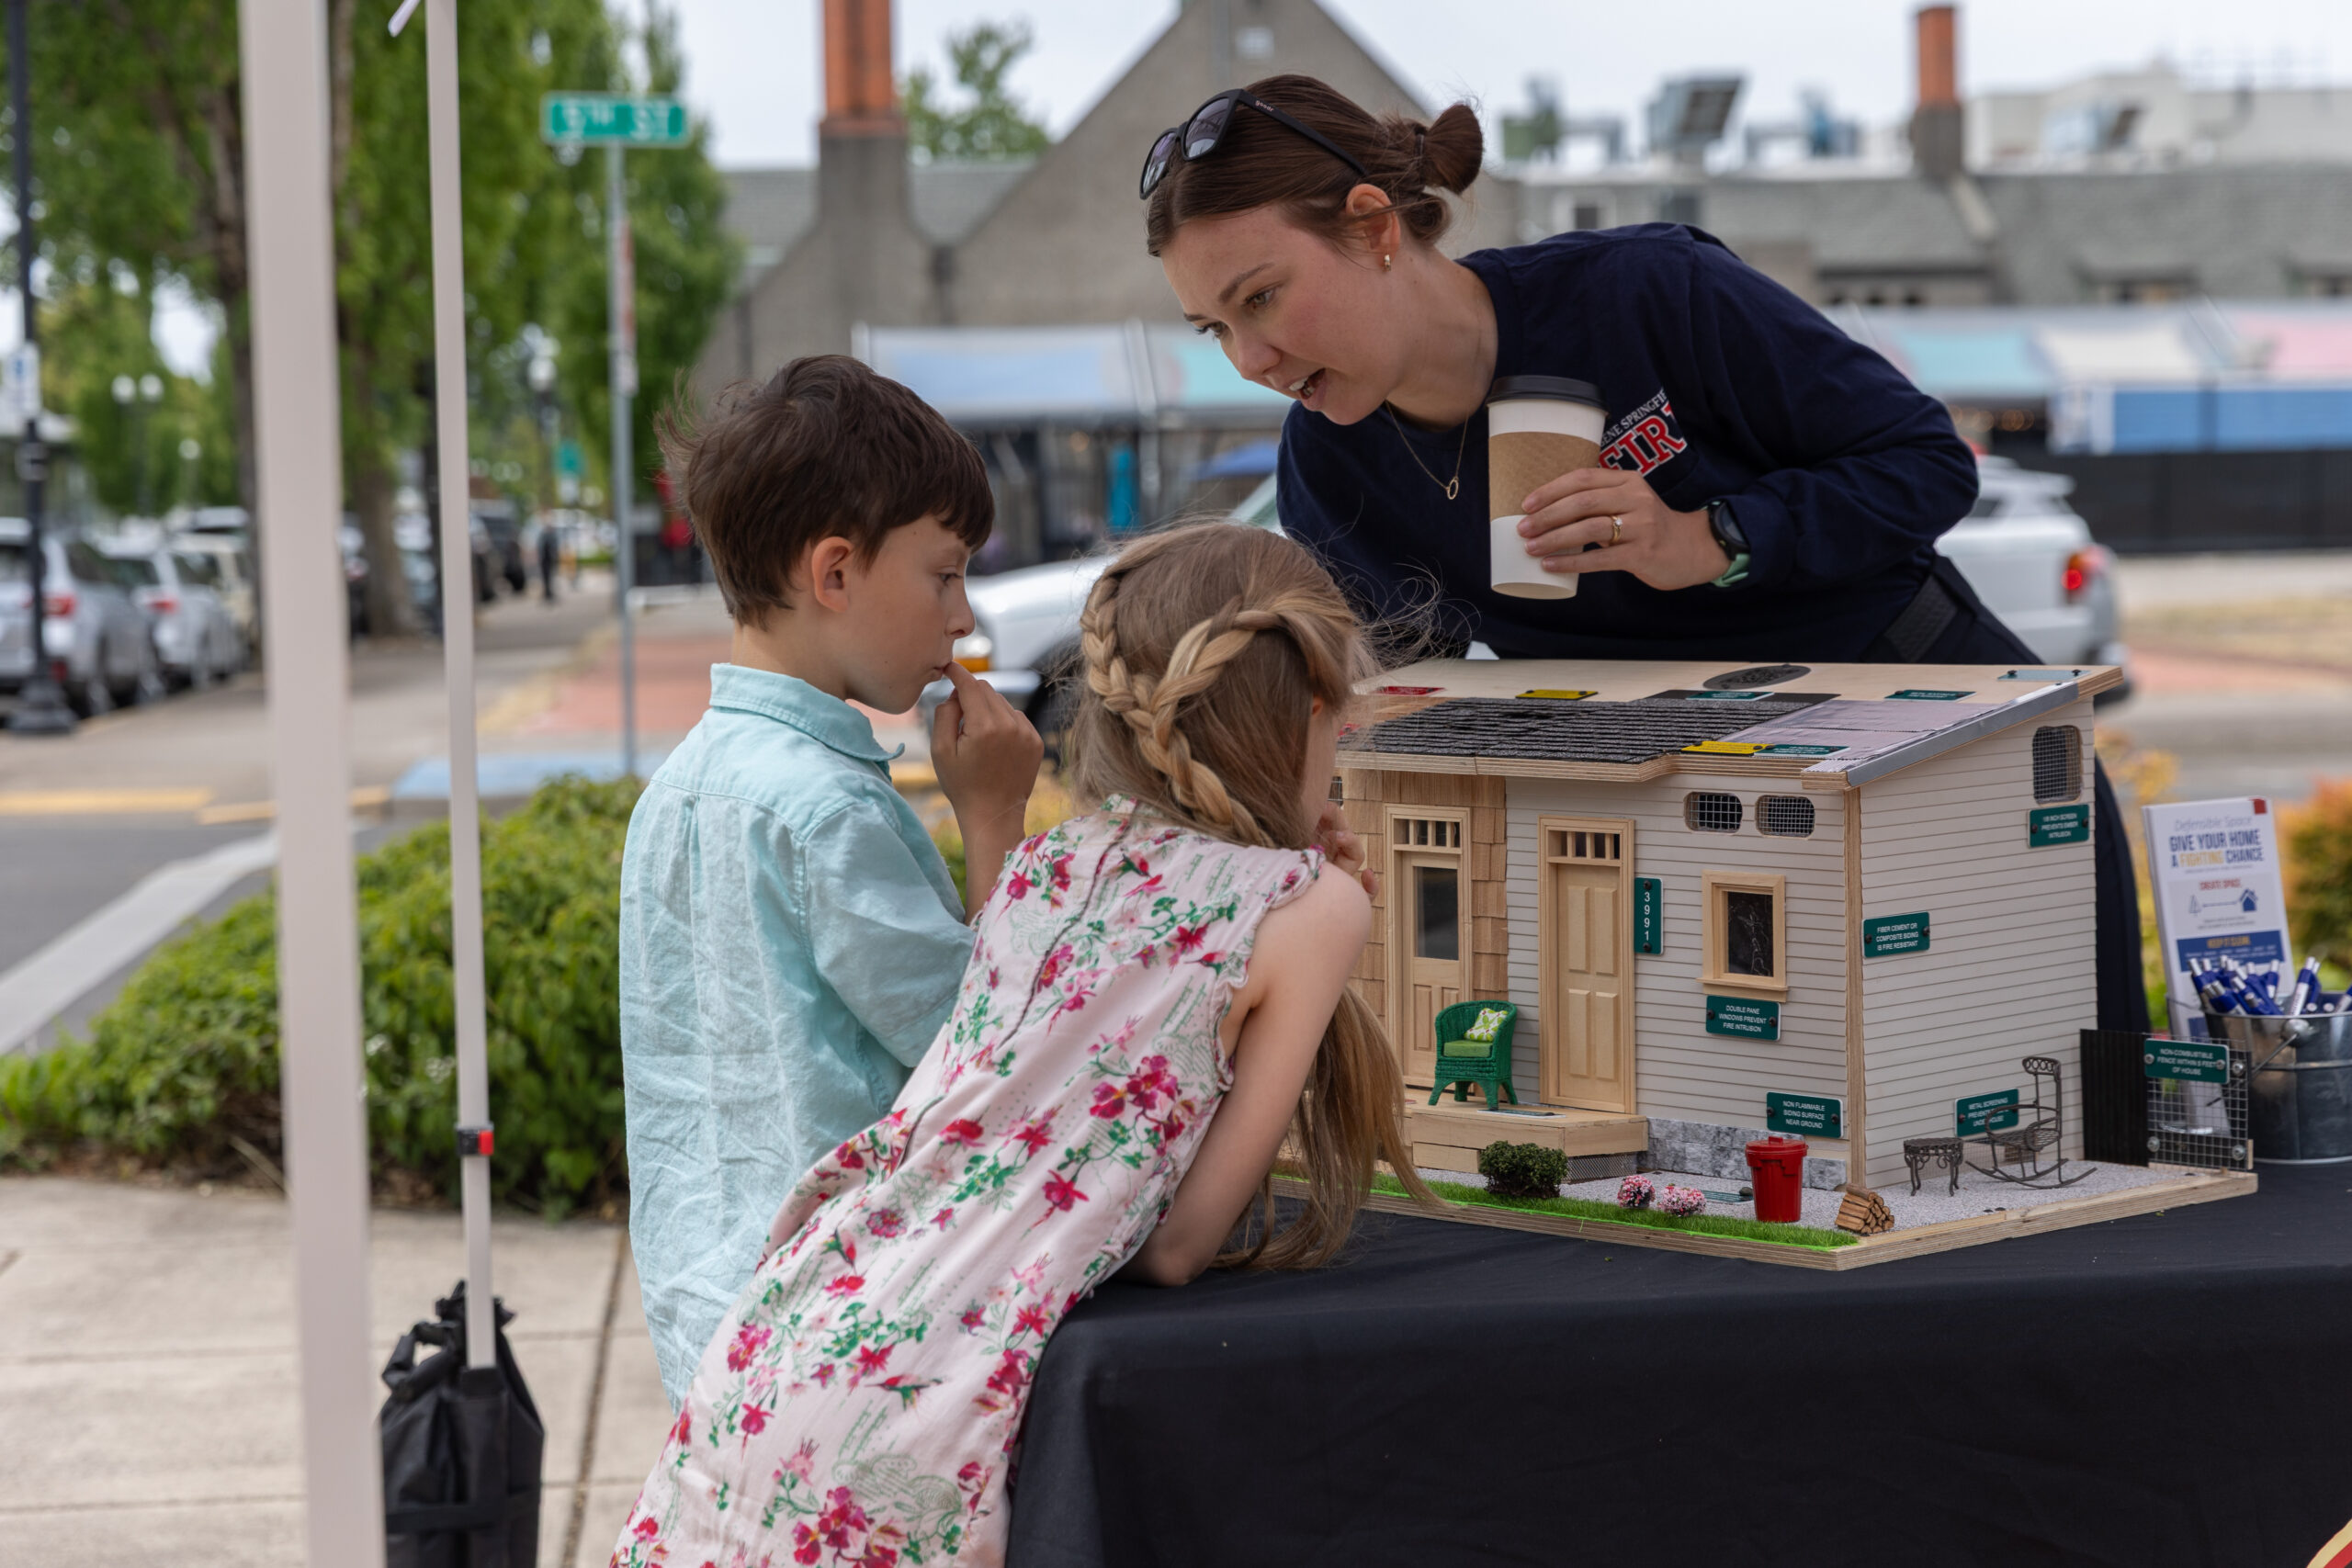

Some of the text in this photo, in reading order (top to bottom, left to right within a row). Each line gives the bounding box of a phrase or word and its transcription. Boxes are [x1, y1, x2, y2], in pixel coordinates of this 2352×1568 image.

[1256, 100, 1273, 111] goodr
[631, 102, 670, 139] ST
[1598, 400, 1688, 477] FIR
[2169, 829, 2262, 852] GIVE YOUR HOME
[2171, 847, 2265, 867] A FIGHTING CHANCE
[1891, 923, 1909, 931] CEMENT
[1876, 933, 1903, 942] COMPOSITE
[1894, 941, 1918, 949] RESISTANT
[1719, 1013, 1743, 1021] WINDOWS
[1735, 1023, 1762, 1032] INTRUSION
[1795, 1102, 1825, 1111] FLAMMABLE
[1801, 1111, 1825, 1121] SURFACE
